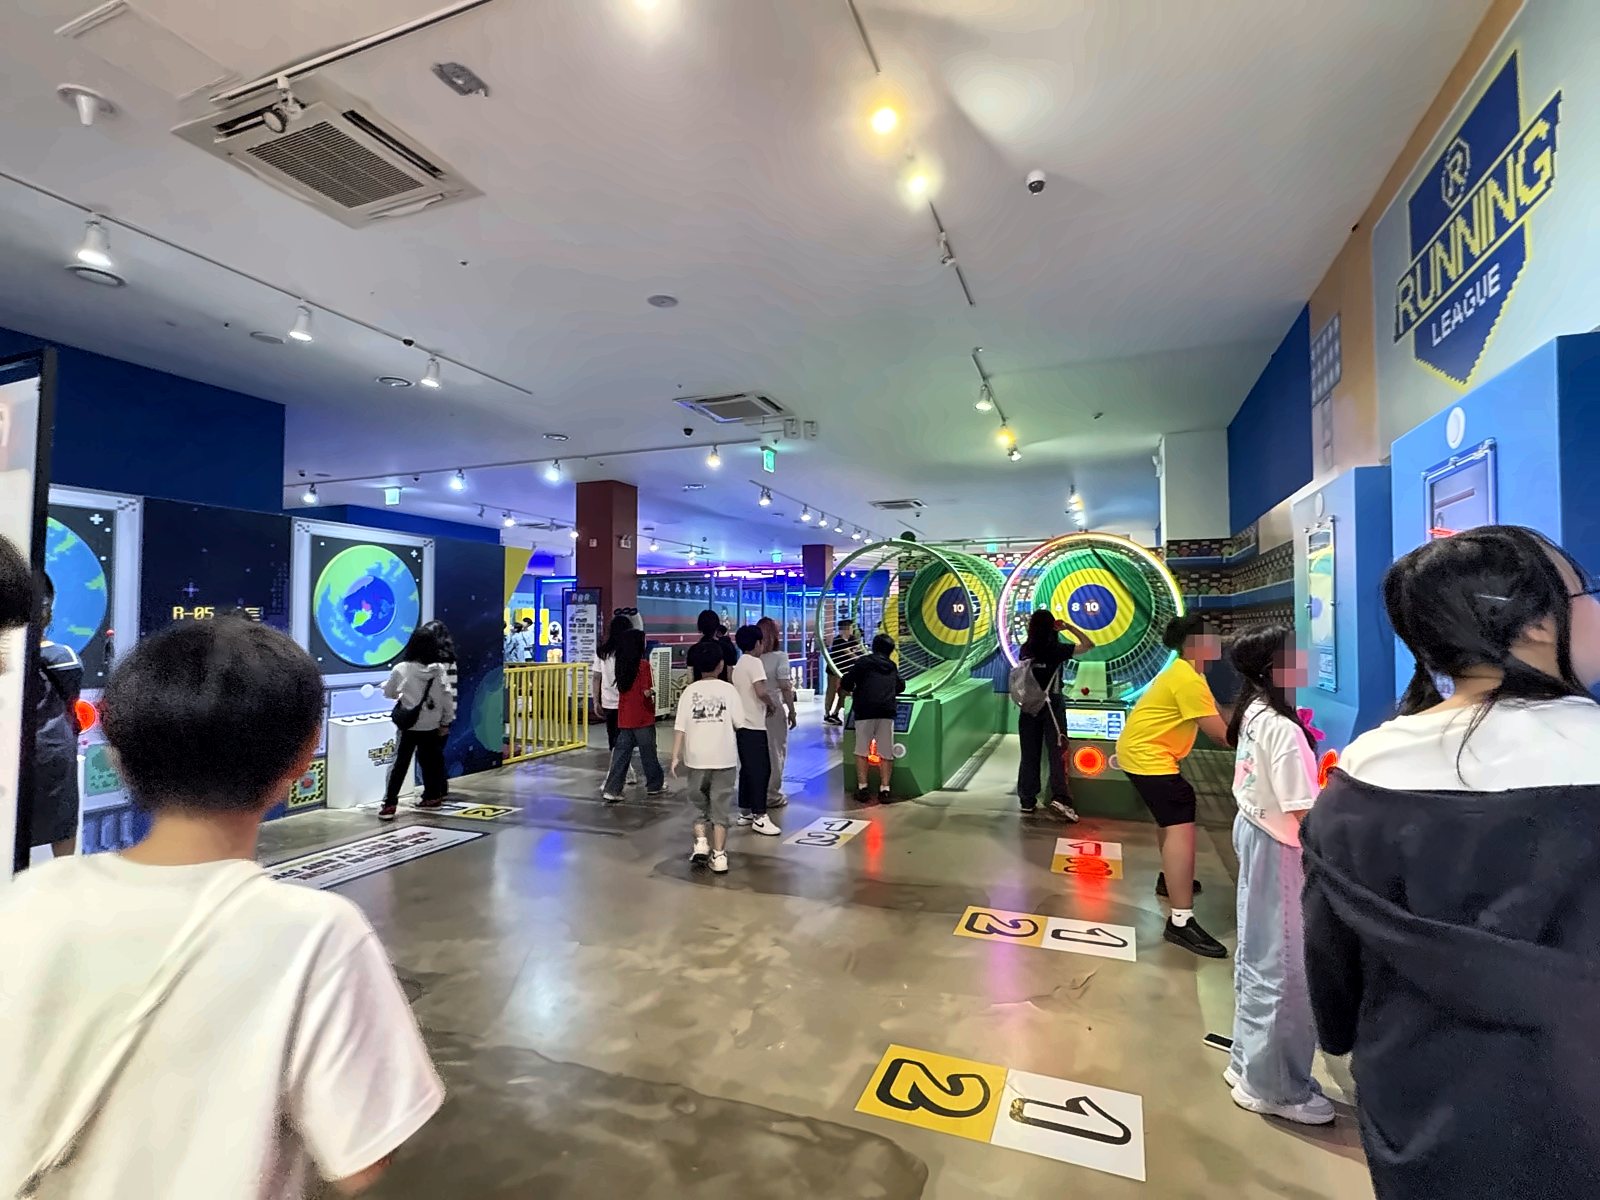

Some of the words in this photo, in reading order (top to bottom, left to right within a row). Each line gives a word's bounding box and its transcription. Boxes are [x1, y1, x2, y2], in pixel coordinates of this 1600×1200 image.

[1396, 118, 1553, 329] RUNNING
[1431, 263, 1501, 347] LEAGUE
[952, 603, 965, 613] 10
[1071, 602, 1081, 612] 8
[1084, 601, 1100, 612] 10
[823, 819, 854, 832] 1
[795, 832, 841, 847] 2
[964, 911, 1039, 938] 2
[1050, 927, 1129, 948] 1
[876, 1058, 991, 1118] 2
[1008, 1095, 1132, 1146] 1
